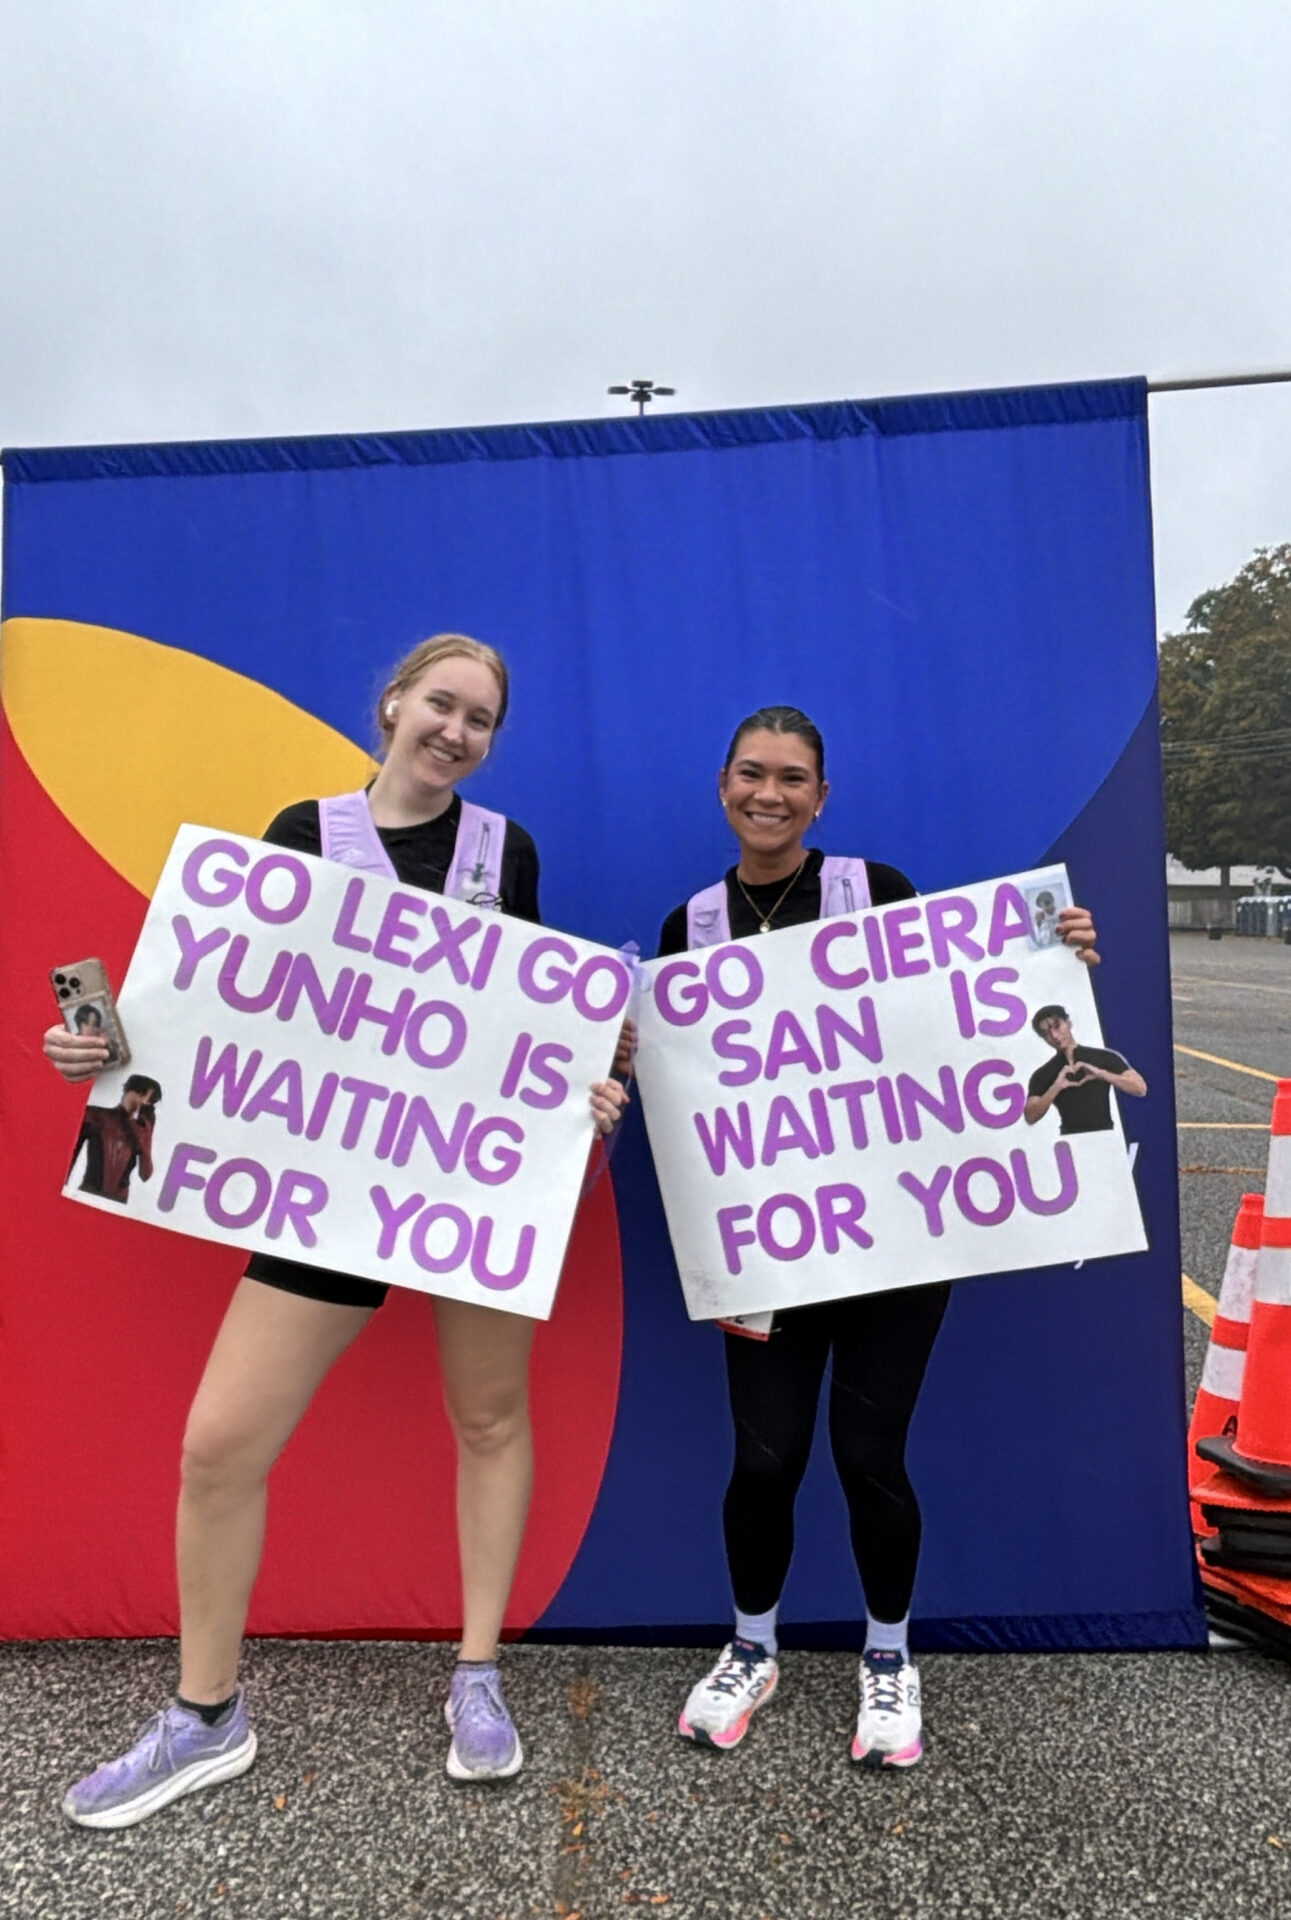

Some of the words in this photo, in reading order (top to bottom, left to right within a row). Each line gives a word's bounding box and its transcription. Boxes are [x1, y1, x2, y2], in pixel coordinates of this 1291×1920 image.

[183, 839, 312, 924] GO
[333, 877, 503, 991] LEXI
[518, 936, 632, 1022] GO
[653, 944, 764, 1027] GO
[810, 882, 1033, 990] CIERA
[172, 914, 468, 1069] YUNHO
[500, 1032, 573, 1110] IS
[711, 996, 884, 1087] SAN
[950, 967, 1028, 1039] IS
[189, 1036, 525, 1186] WAITING
[694, 1059, 1028, 1177] WAITING
[157, 1142, 329, 1249] FOR
[370, 1185, 537, 1292] YOU
[717, 1183, 874, 1275] FOR
[898, 1140, 1079, 1237] YOU
